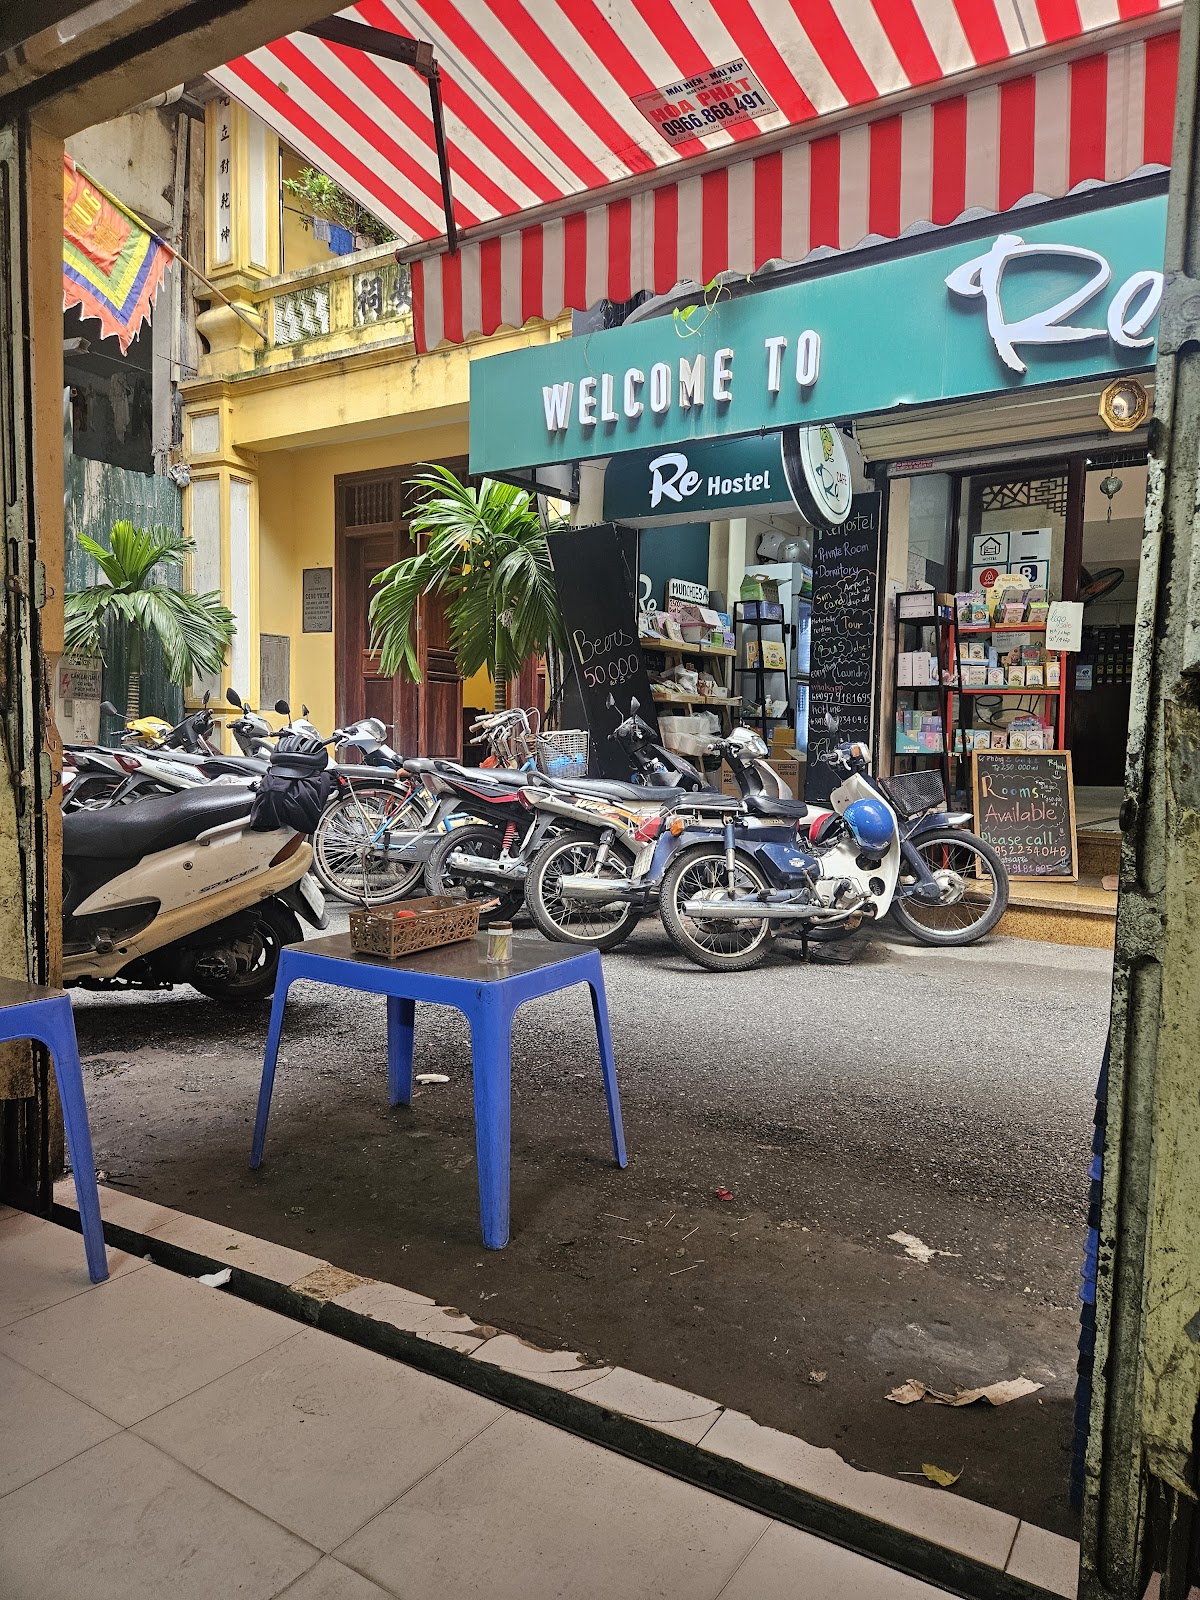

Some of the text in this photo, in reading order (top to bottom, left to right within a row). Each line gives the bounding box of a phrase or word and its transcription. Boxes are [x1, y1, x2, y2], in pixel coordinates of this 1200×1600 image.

[695, 77, 753, 107] PHÁT
[662, 91, 766, 137] 0966.868.491
[944, 234, 1165, 374] Re
[542, 329, 821, 431] WELCOME TO
[649, 453, 771, 508] Re Hostel
[843, 541, 869, 556] Room
[817, 562, 859, 579] Dormitory
[672, 582, 703, 601] MUNCHIES
[840, 616, 863, 630] Tour
[981, 775, 1039, 800] Rooms
[994, 845, 1067, 857] 852234048
